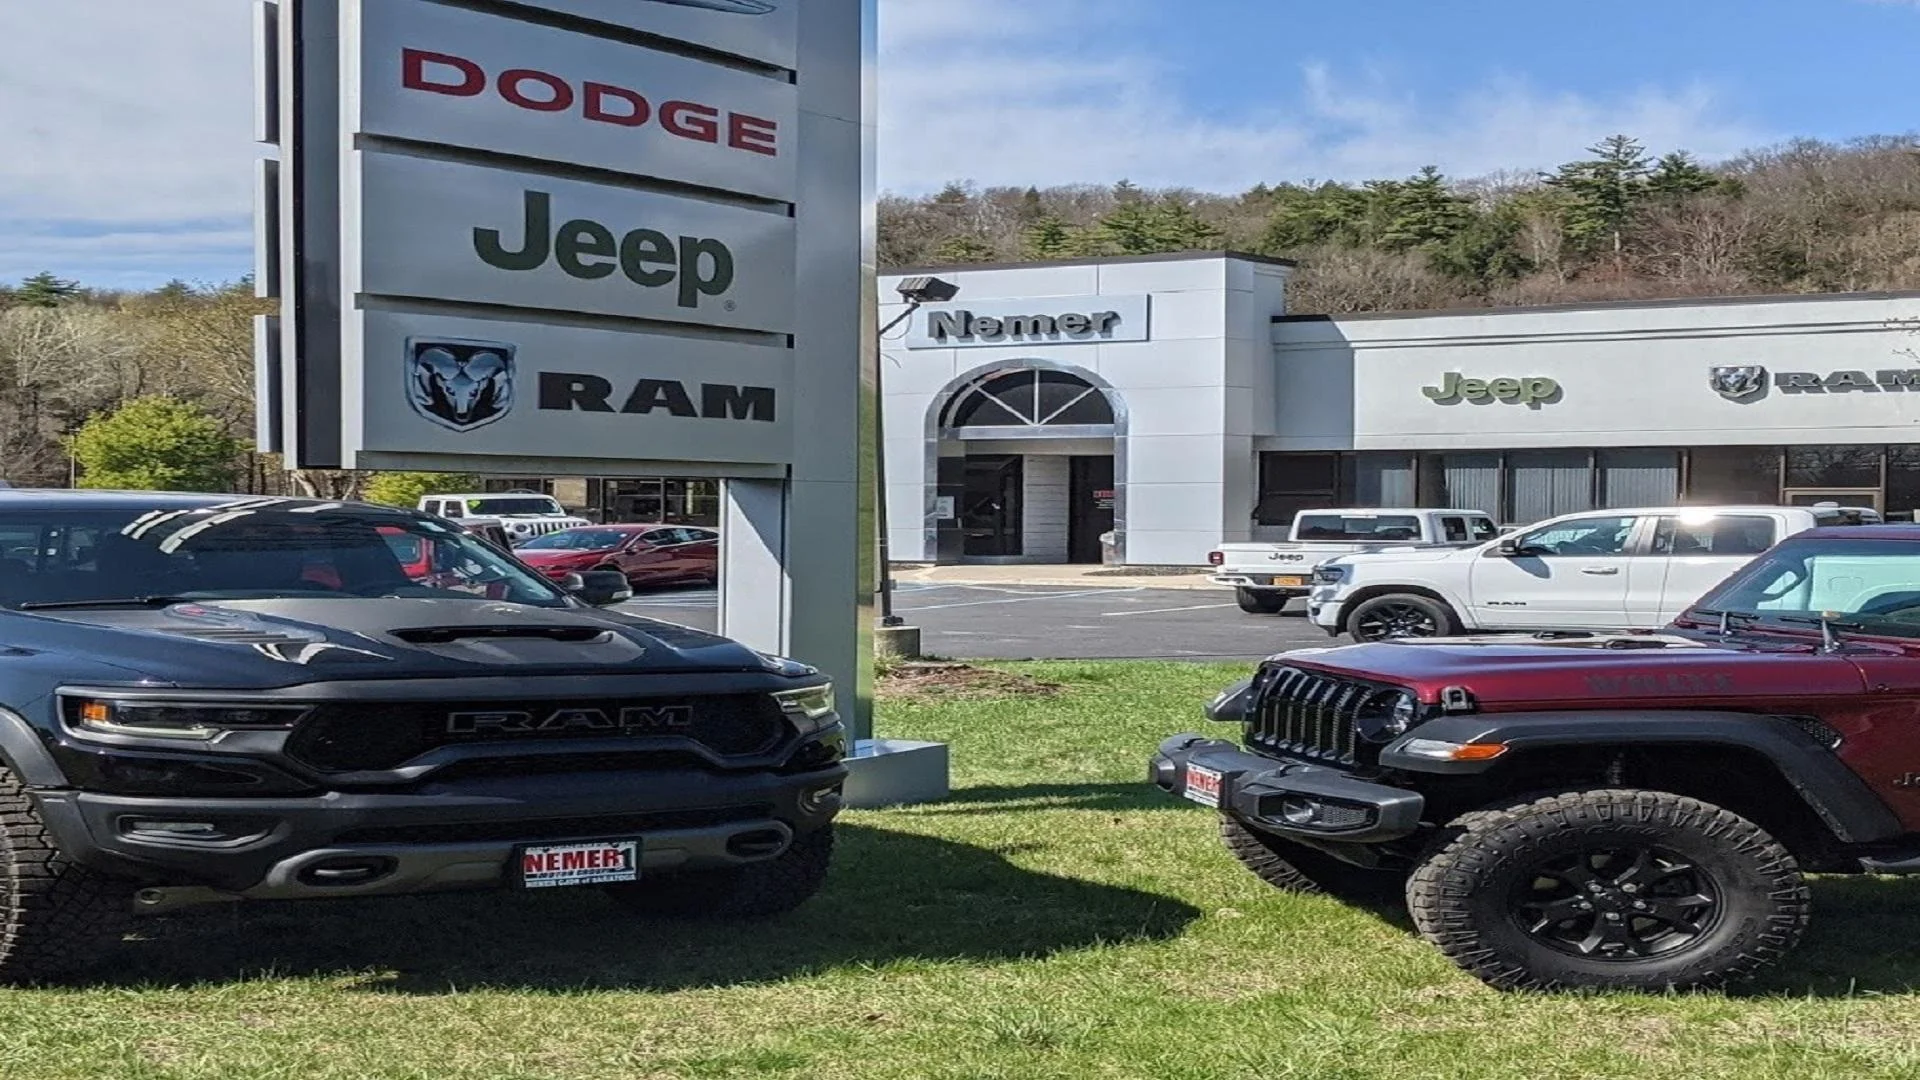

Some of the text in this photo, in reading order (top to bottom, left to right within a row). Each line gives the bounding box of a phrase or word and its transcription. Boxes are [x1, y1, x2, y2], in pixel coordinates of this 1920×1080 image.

[402, 47, 778, 157] DODGE
[473, 189, 735, 308] Jeep
[927, 310, 1122, 340] Nemer
[1421, 371, 1559, 405] Jeep
[1774, 369, 1920, 389] RAM
[538, 371, 776, 423] RAM
[1268, 552, 1304, 561] Jeep
[446, 705, 693, 733] RAM
[523, 848, 620, 873] NEMER
